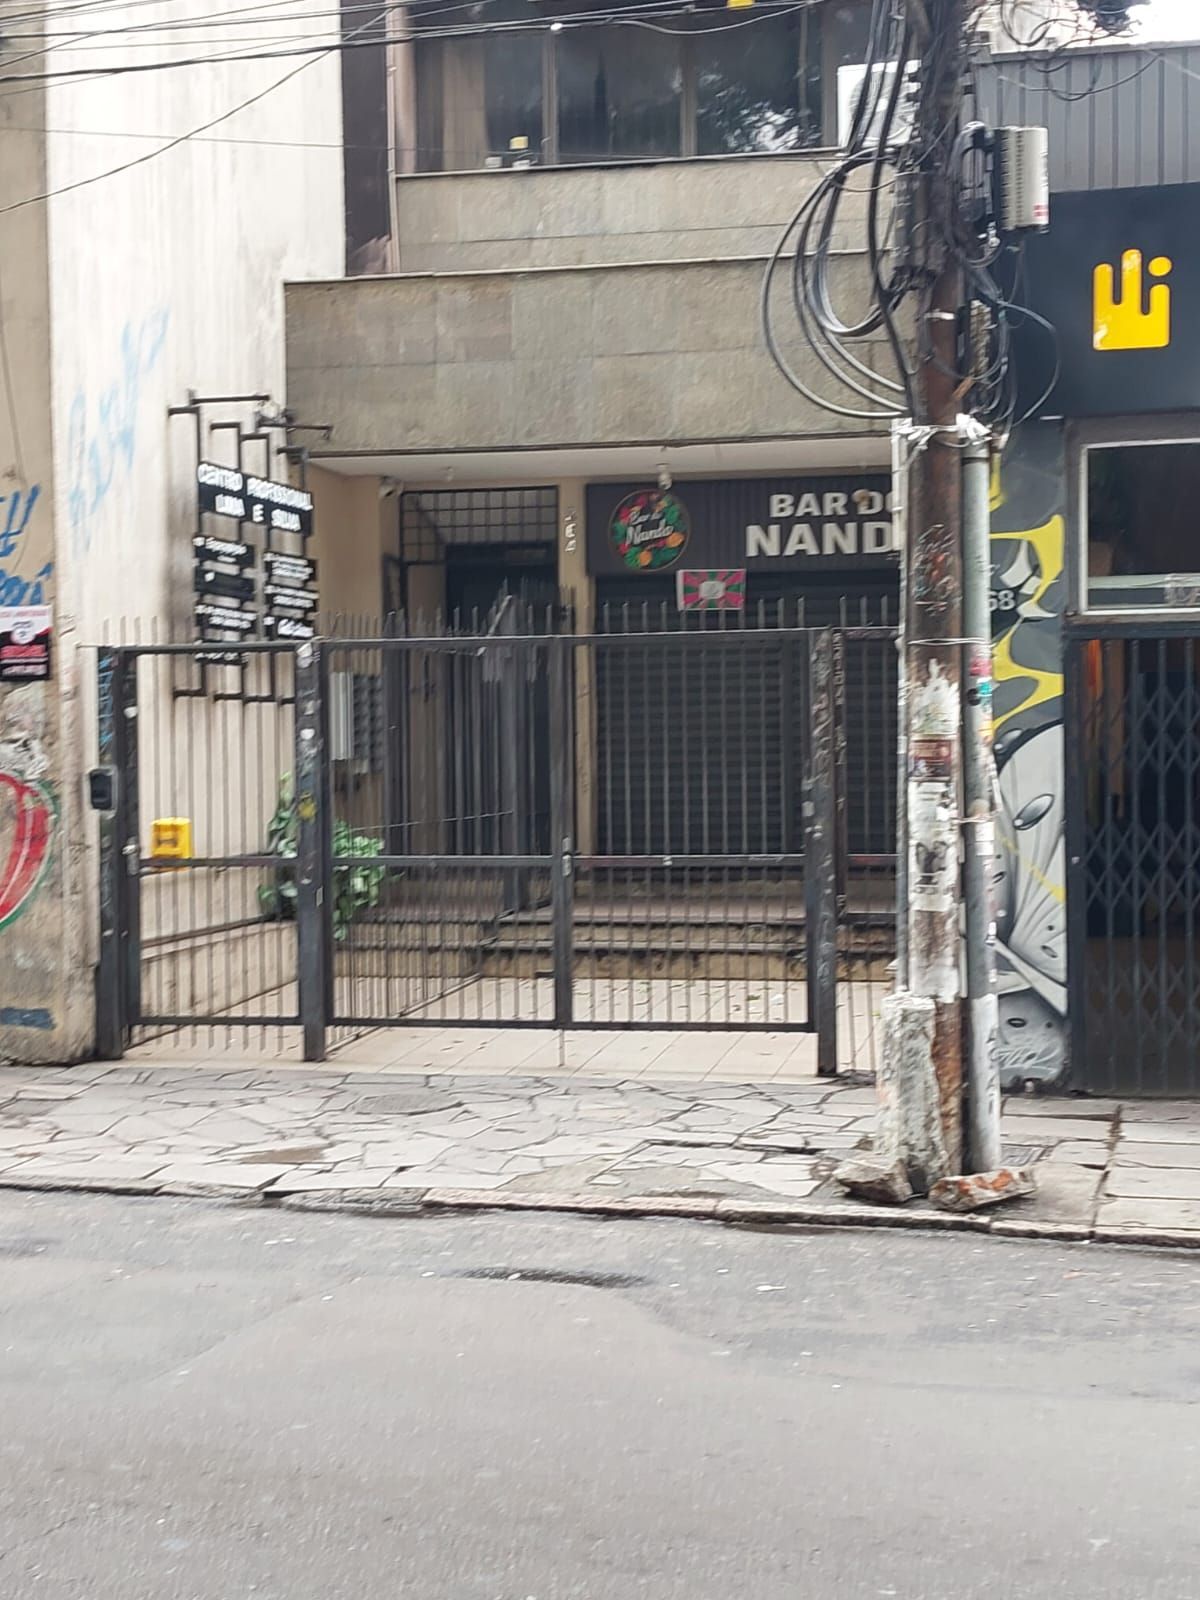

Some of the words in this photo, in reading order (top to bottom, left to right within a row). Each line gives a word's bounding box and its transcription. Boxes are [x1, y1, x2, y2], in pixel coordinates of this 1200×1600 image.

[198, 463, 243, 492] CENTRO
[252, 504, 264, 523] E
[769, 492, 848, 517] BAR
[746, 521, 893, 557] NAND
